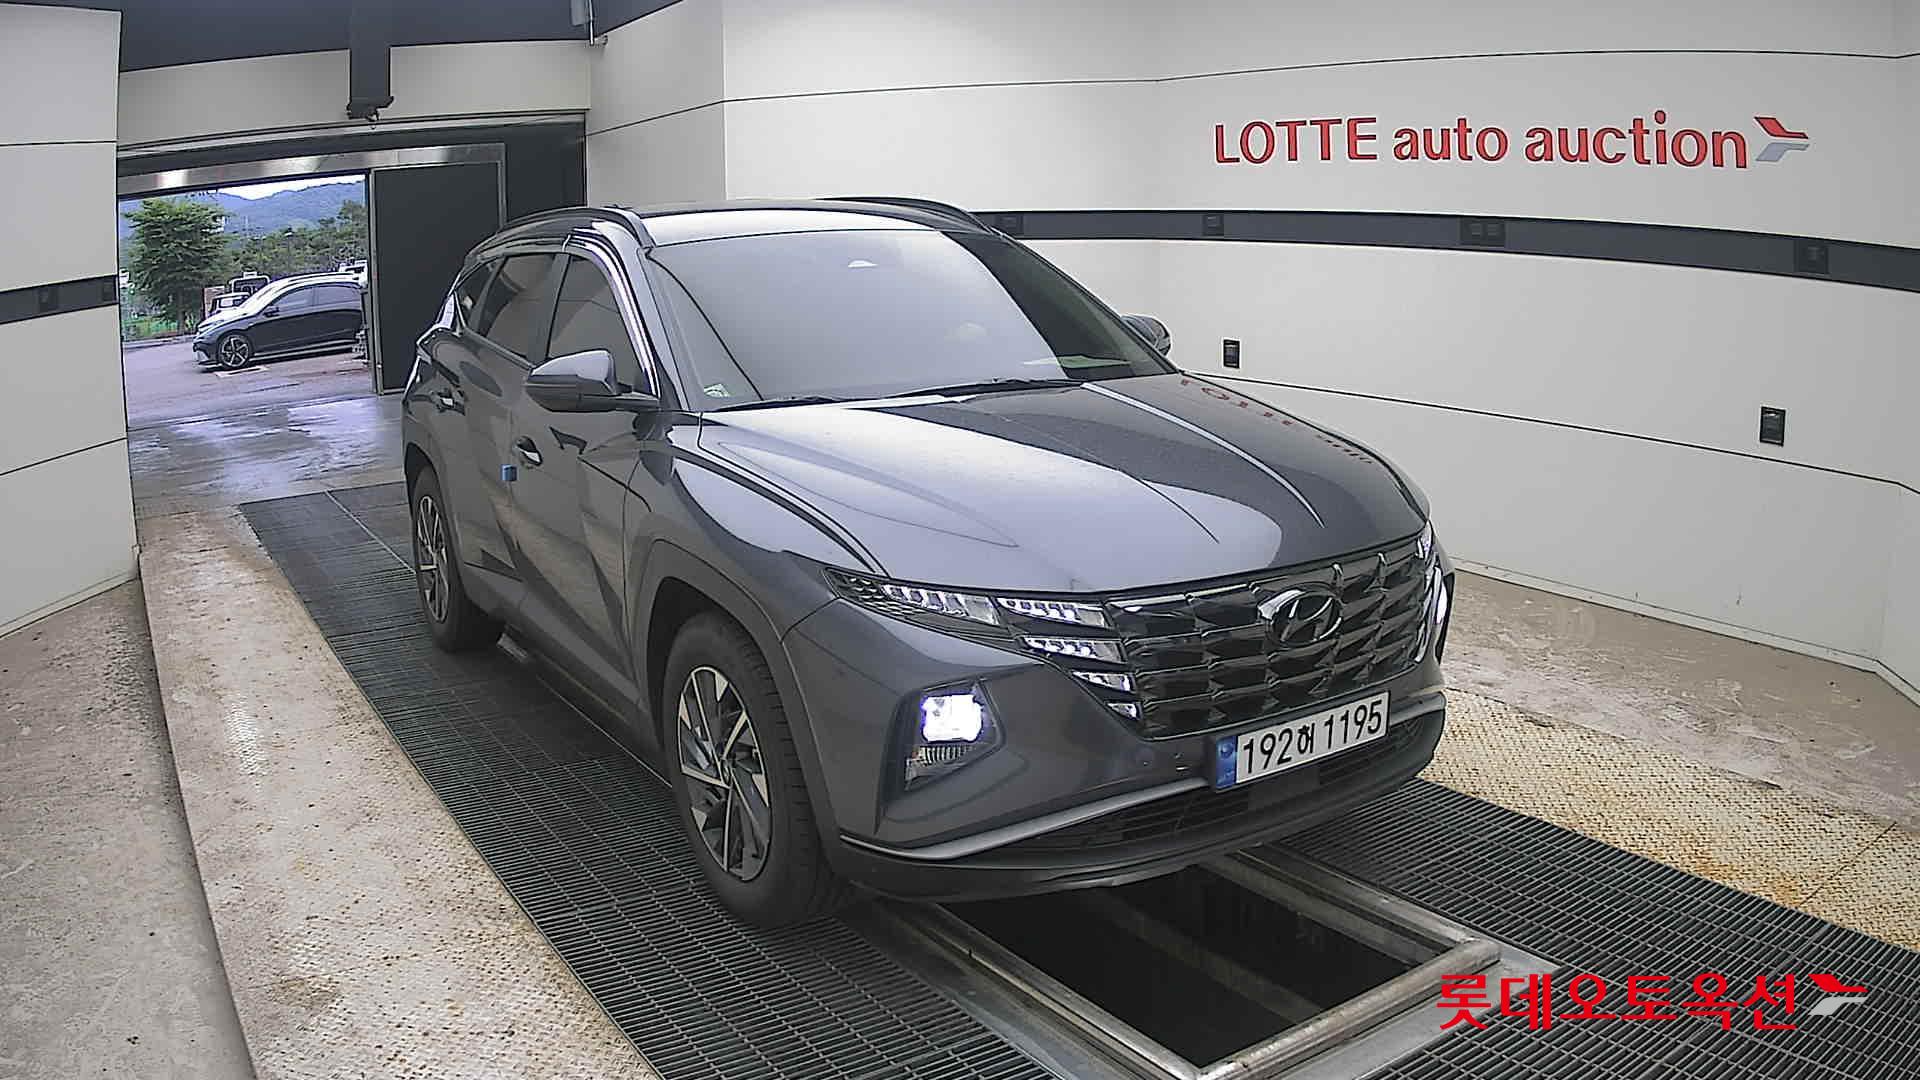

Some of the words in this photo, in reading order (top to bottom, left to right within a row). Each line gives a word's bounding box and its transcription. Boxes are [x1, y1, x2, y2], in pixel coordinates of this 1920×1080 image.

[1215, 116, 1378, 165] LOTTE
[1392, 117, 1509, 163] auto
[1524, 109, 1749, 169] auction
[1242, 722, 1315, 774] 192허
[1323, 699, 1383, 750] 1195
